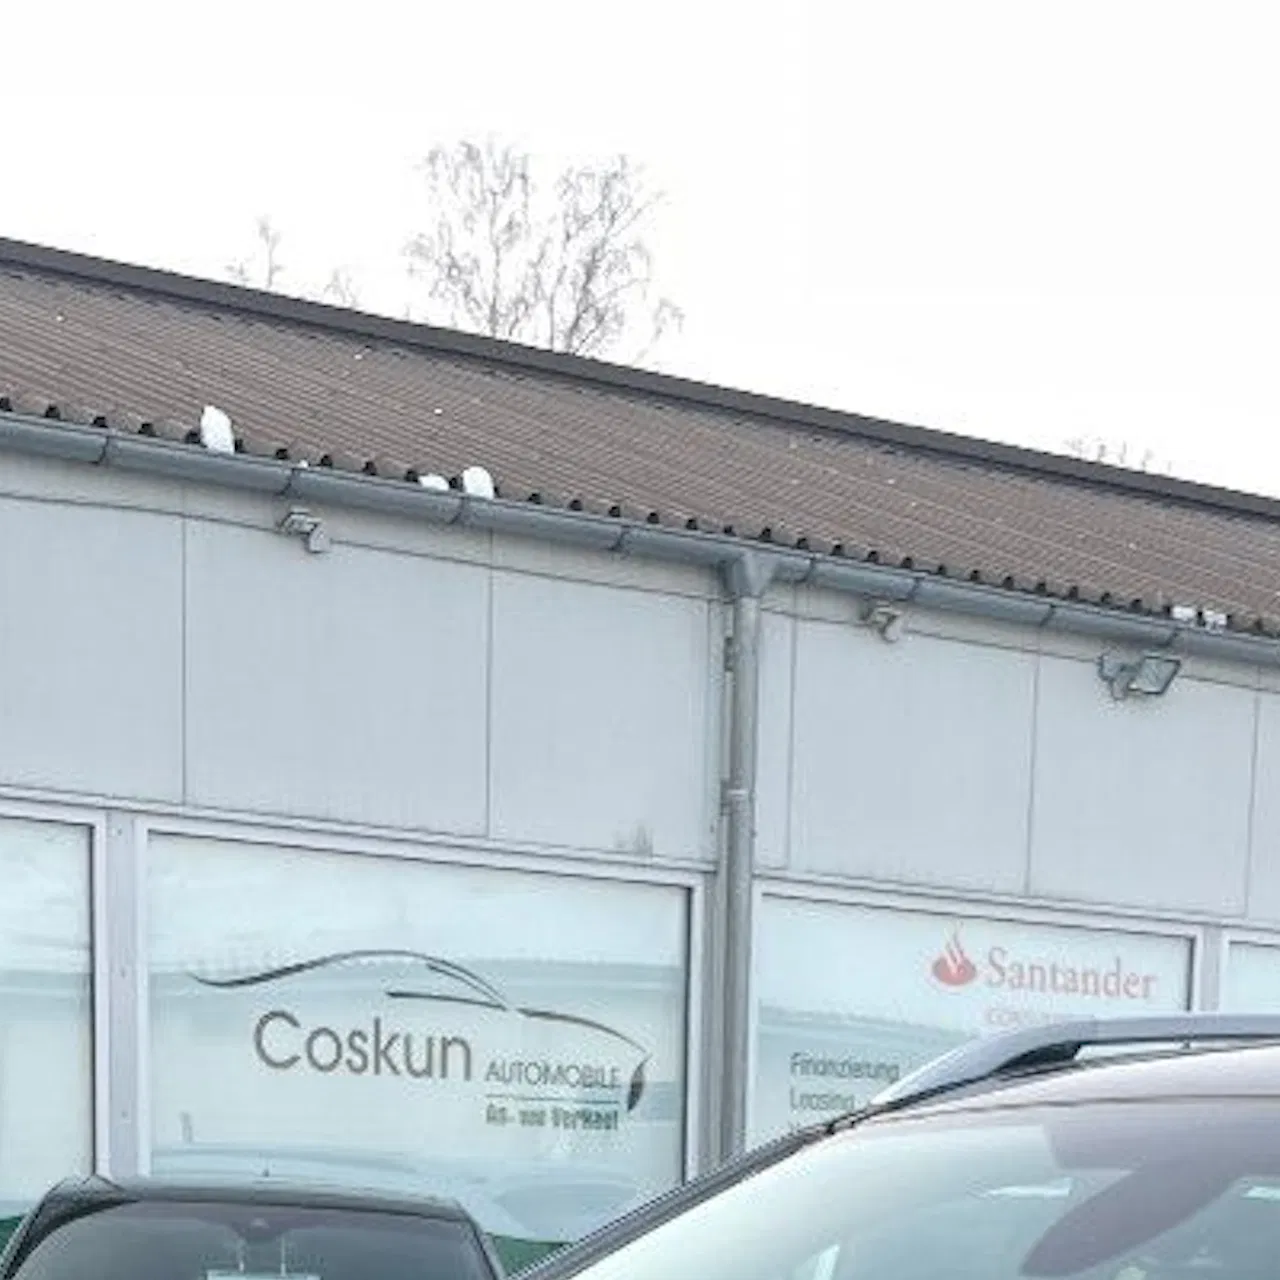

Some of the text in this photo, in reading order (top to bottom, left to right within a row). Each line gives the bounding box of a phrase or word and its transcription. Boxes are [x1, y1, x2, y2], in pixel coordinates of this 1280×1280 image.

[986, 946, 1158, 999] Santander
[253, 1010, 473, 1082] Coskun
[485, 1060, 621, 1089] AUTOMOBILE
